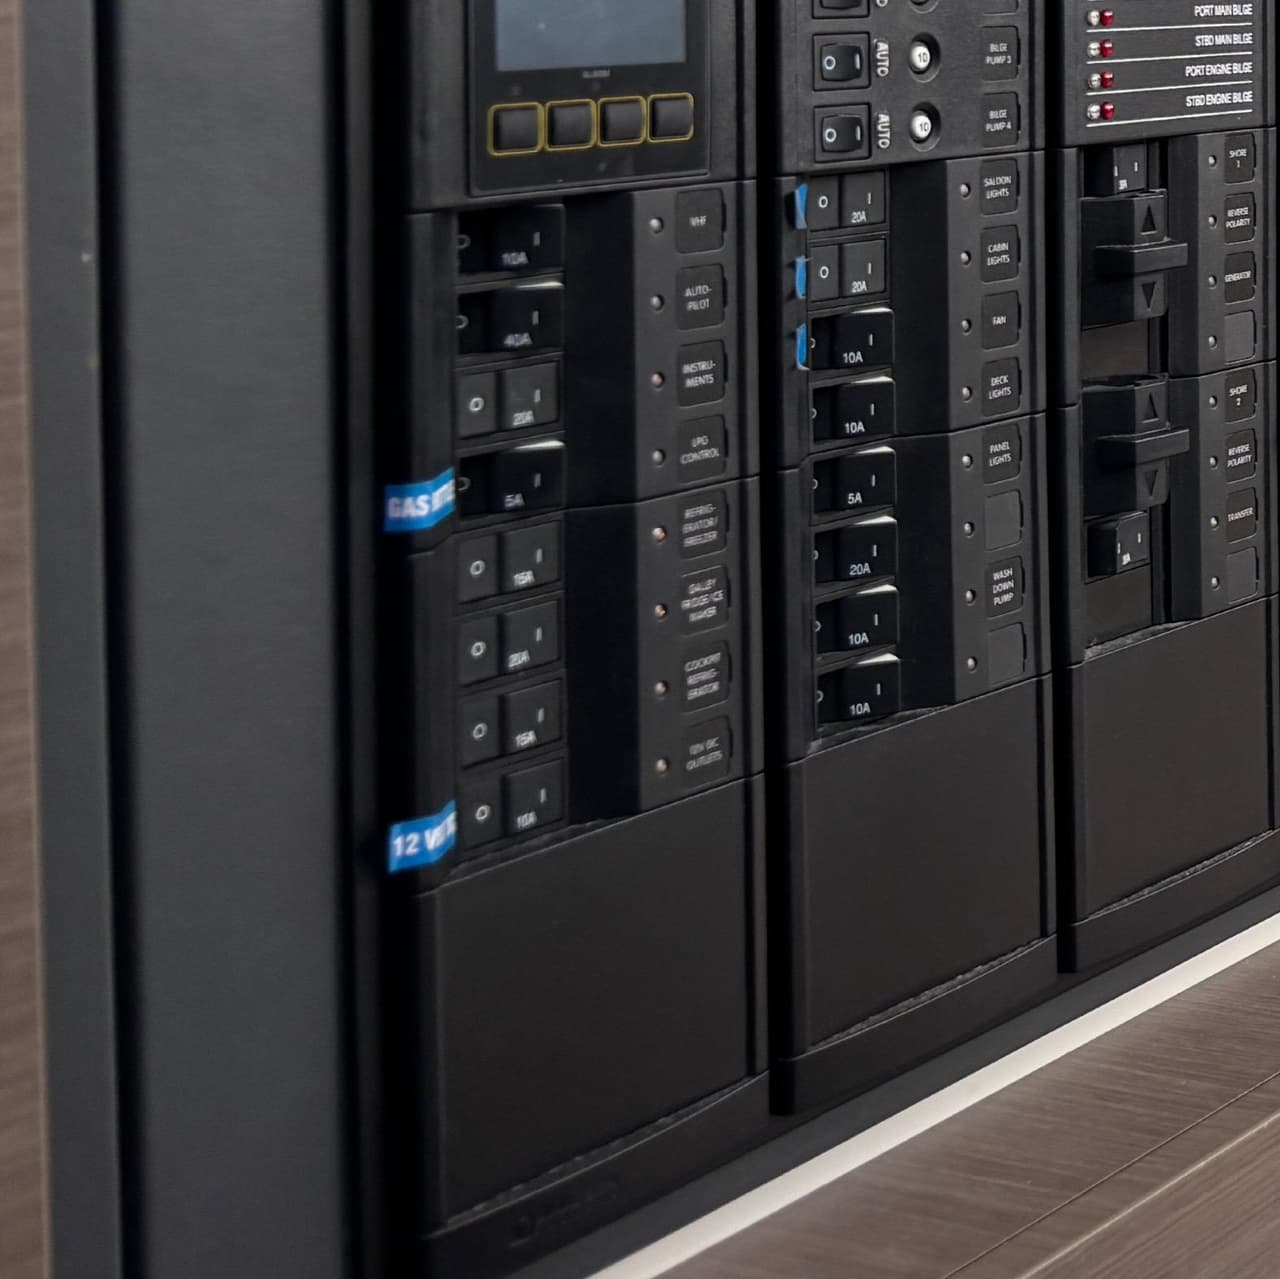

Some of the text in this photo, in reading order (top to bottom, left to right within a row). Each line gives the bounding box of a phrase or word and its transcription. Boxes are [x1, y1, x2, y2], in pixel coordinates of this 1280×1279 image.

[1194, 4, 1253, 17] PORT MAIN BILGE
[1194, 33, 1253, 47] STBD MAIN BILGE
[989, 43, 1008, 53] BILGE
[875, 40, 889, 78] AUTO
[918, 52, 929, 63] 10
[986, 55, 1005, 66] PUMP
[1185, 62, 1253, 77] PORT ENGINE BILGE
[1185, 91, 1253, 107] STBD ENGINE BILGE
[989, 109, 1008, 120] BILGE
[877, 112, 890, 149] AUTO
[919, 122, 929, 133] 10
[986, 121, 1005, 132] PUMP
[1229, 149, 1247, 158] SHORE
[984, 176, 1011, 186] SALOON
[986, 188, 1009, 199] LIGHTS
[851, 211, 867, 223] 20A
[1227, 207, 1249, 217] REVERSE
[1225, 219, 1250, 229] POLARITY
[988, 242, 1009, 253] CABIN
[987, 255, 1010, 266] LIGHTS
[1224, 271, 1251, 282] GENERATOR
[685, 285, 712, 297] AUTO-
[851, 280, 867, 293] 20A
[687, 299, 710, 311] PILOT
[843, 351, 863, 364] 10A
[682, 361, 716, 374] INSTRU-
[685, 374, 714, 388] MENTS
[991, 375, 1008, 386] DECK
[989, 387, 1011, 400] LIGHTS
[1229, 385, 1248, 396] SHORE
[844, 421, 865, 433] 10A
[990, 442, 1010, 453] PANEL
[680, 448, 720, 464] CONTROL
[989, 454, 1012, 466] LIGHTS
[1227, 454, 1252, 468] POLARITY
[504, 493, 525, 508] 5A
[847, 492, 862, 504] 5A
[1227, 507, 1254, 522] TRANSFER
[849, 563, 871, 575] 20A
[993, 568, 1013, 581] WASH
[993, 580, 1014, 593] DOWN
[994, 593, 1014, 606] PUMP
[848, 632, 869, 645] 10A
[850, 702, 870, 715] 10A
[393, 831, 420, 857] 12
